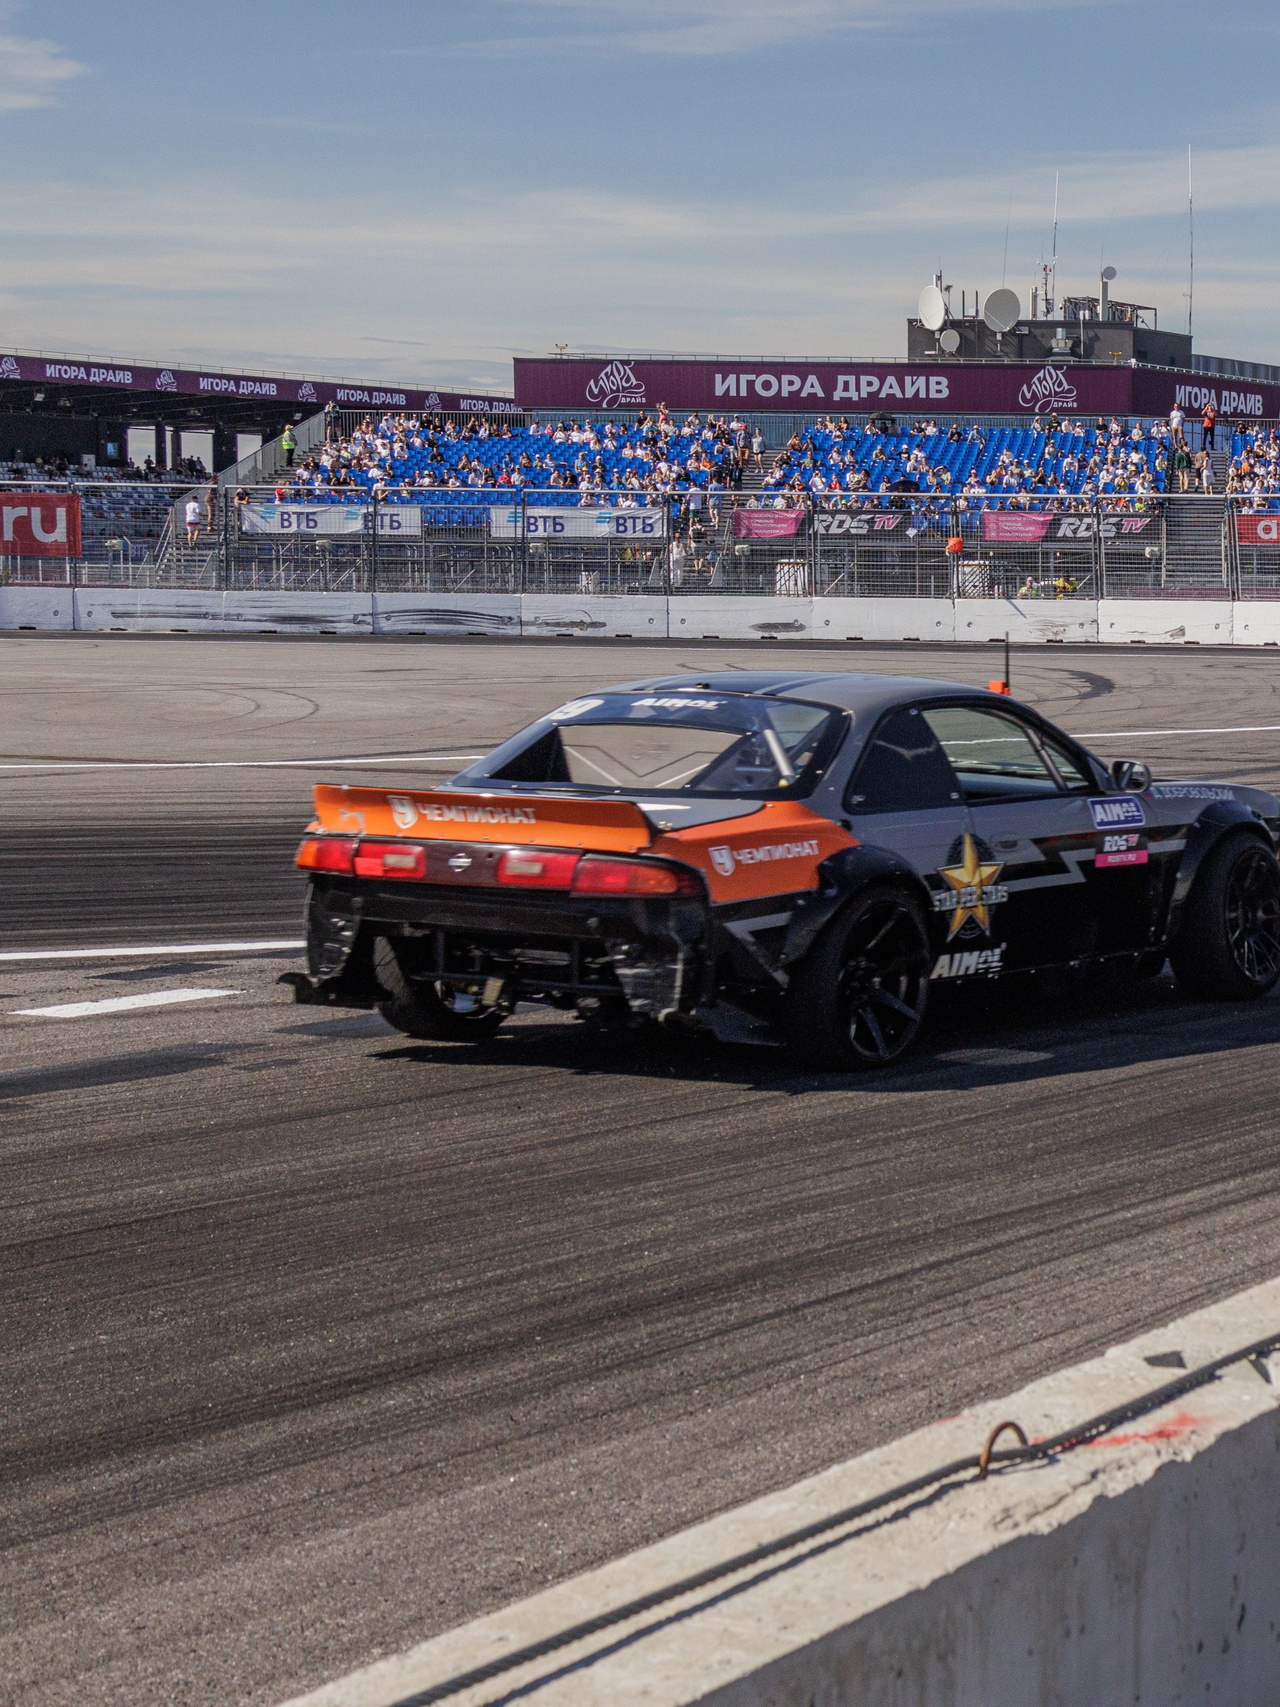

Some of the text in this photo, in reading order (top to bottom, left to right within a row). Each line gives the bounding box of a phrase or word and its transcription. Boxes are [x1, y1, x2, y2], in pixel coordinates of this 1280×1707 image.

[46, 364, 133, 384] ИГОРА ДРАЙВ
[200, 377, 278, 395] ИГОРА ДРАЙВ
[714, 373, 950, 401] ИГОРА ДРАЙВ
[336, 388, 406, 405] ИГОРА ДРАЙВ
[460, 399, 491, 411] ИГОРА
[1176, 384, 1263, 415] ИГОРА ДРАЙВ
[280, 511, 319, 529] ВТБ
[363, 513, 402, 530] ВТБ
[526, 515, 565, 533] ВТБ
[615, 516, 655, 534] ВТБ
[809, 514, 903, 534] RDS TV
[1121, 518, 1151, 533] TV
[417, 802, 536, 824] ЧЕМПИОНАТ
[1103, 834, 1128, 852] RDS
[733, 840, 820, 865] ЧЕМПИОНАТ
